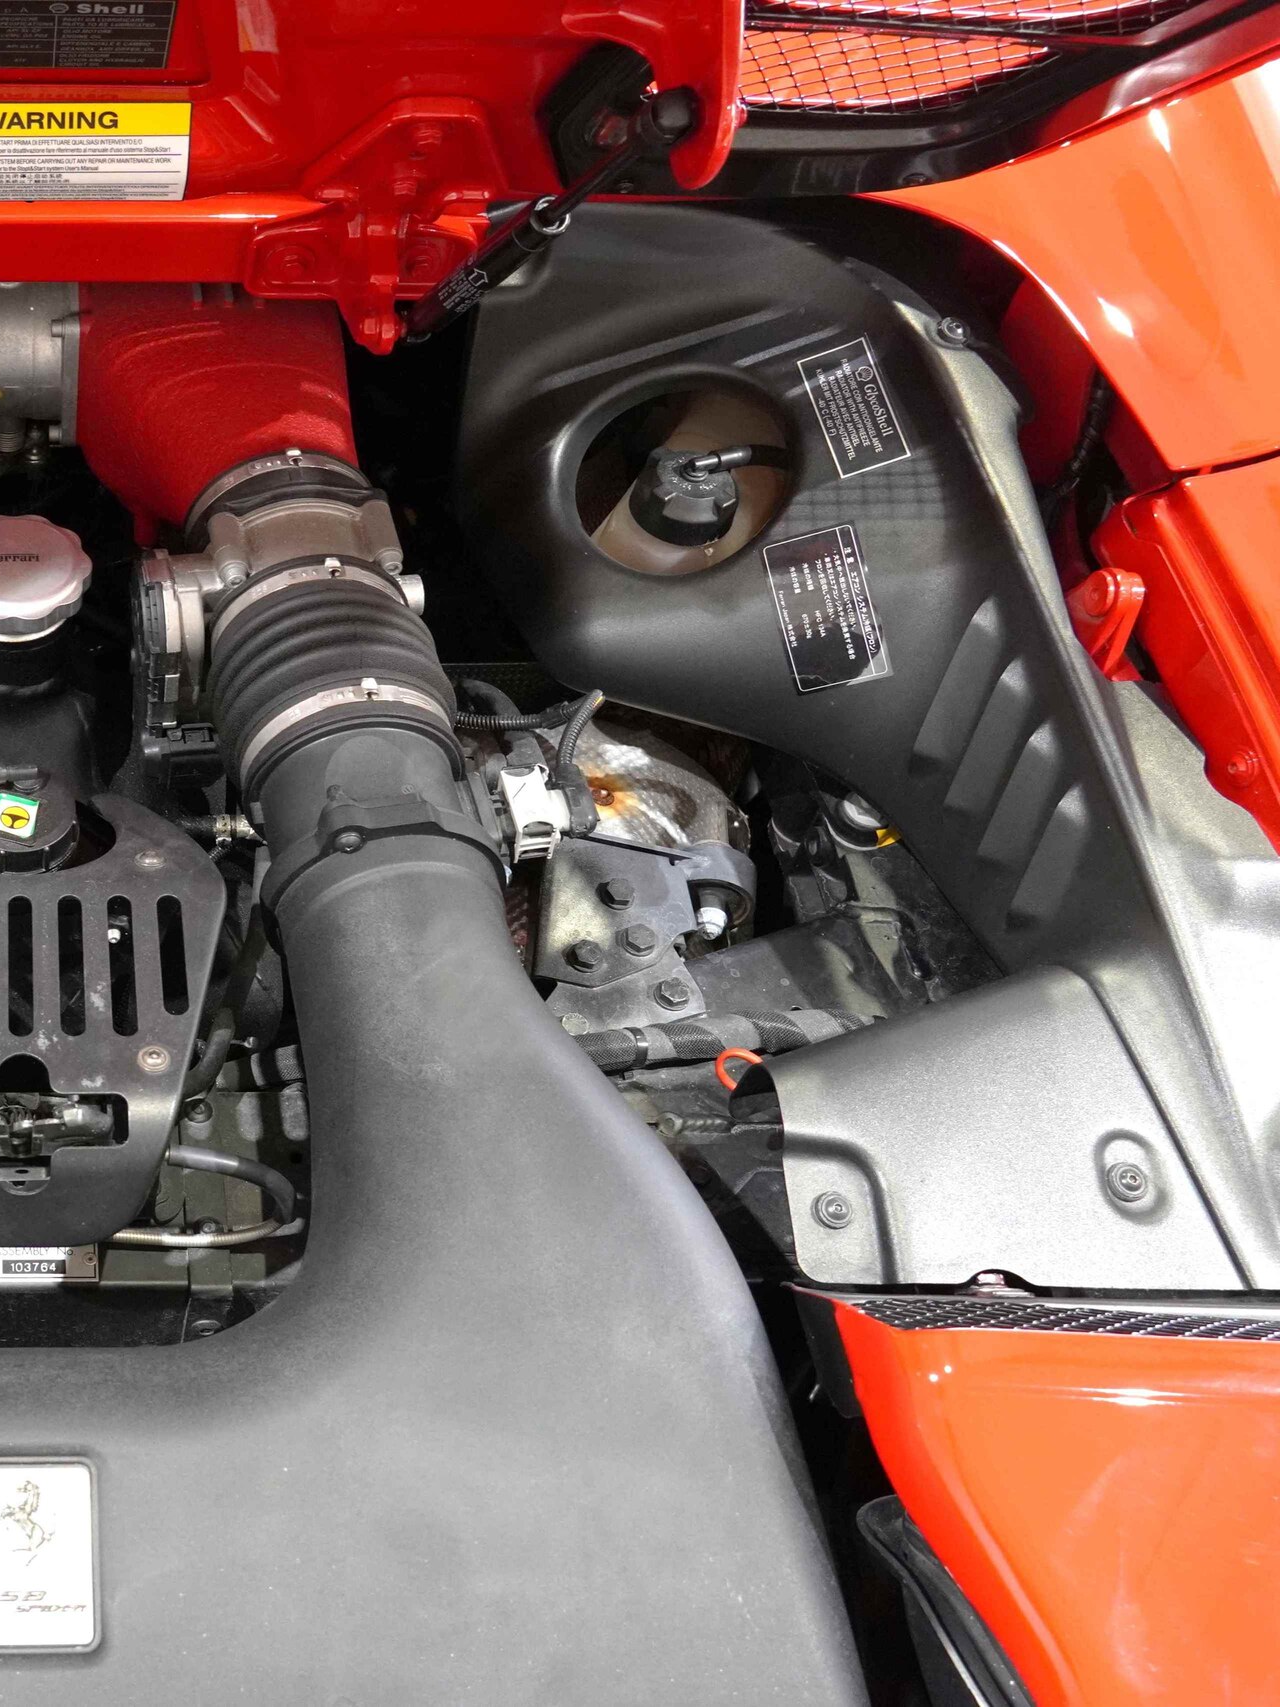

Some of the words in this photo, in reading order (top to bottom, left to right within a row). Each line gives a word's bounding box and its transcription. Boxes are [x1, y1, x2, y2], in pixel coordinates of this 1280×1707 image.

[76, 4, 144, 14] Shell
[828, 376, 844, 406] RADIATEUR
[840, 407, 849, 421] AVEC
[847, 423, 859, 446] ANTIGEL
[829, 401, 855, 459] FROSTSCHUTZMITTEL
[835, 370, 850, 397] RADIATOR
[847, 398, 856, 412] WITH
[852, 412, 869, 446] ANTIFREEZE
[840, 359, 855, 388] RADIATORE
[852, 390, 860, 402] CON
[857, 403, 881, 452] ANTICONGELANTE
[863, 383, 892, 436] GlycoShell
[10, 1262, 57, 1272] 103764
